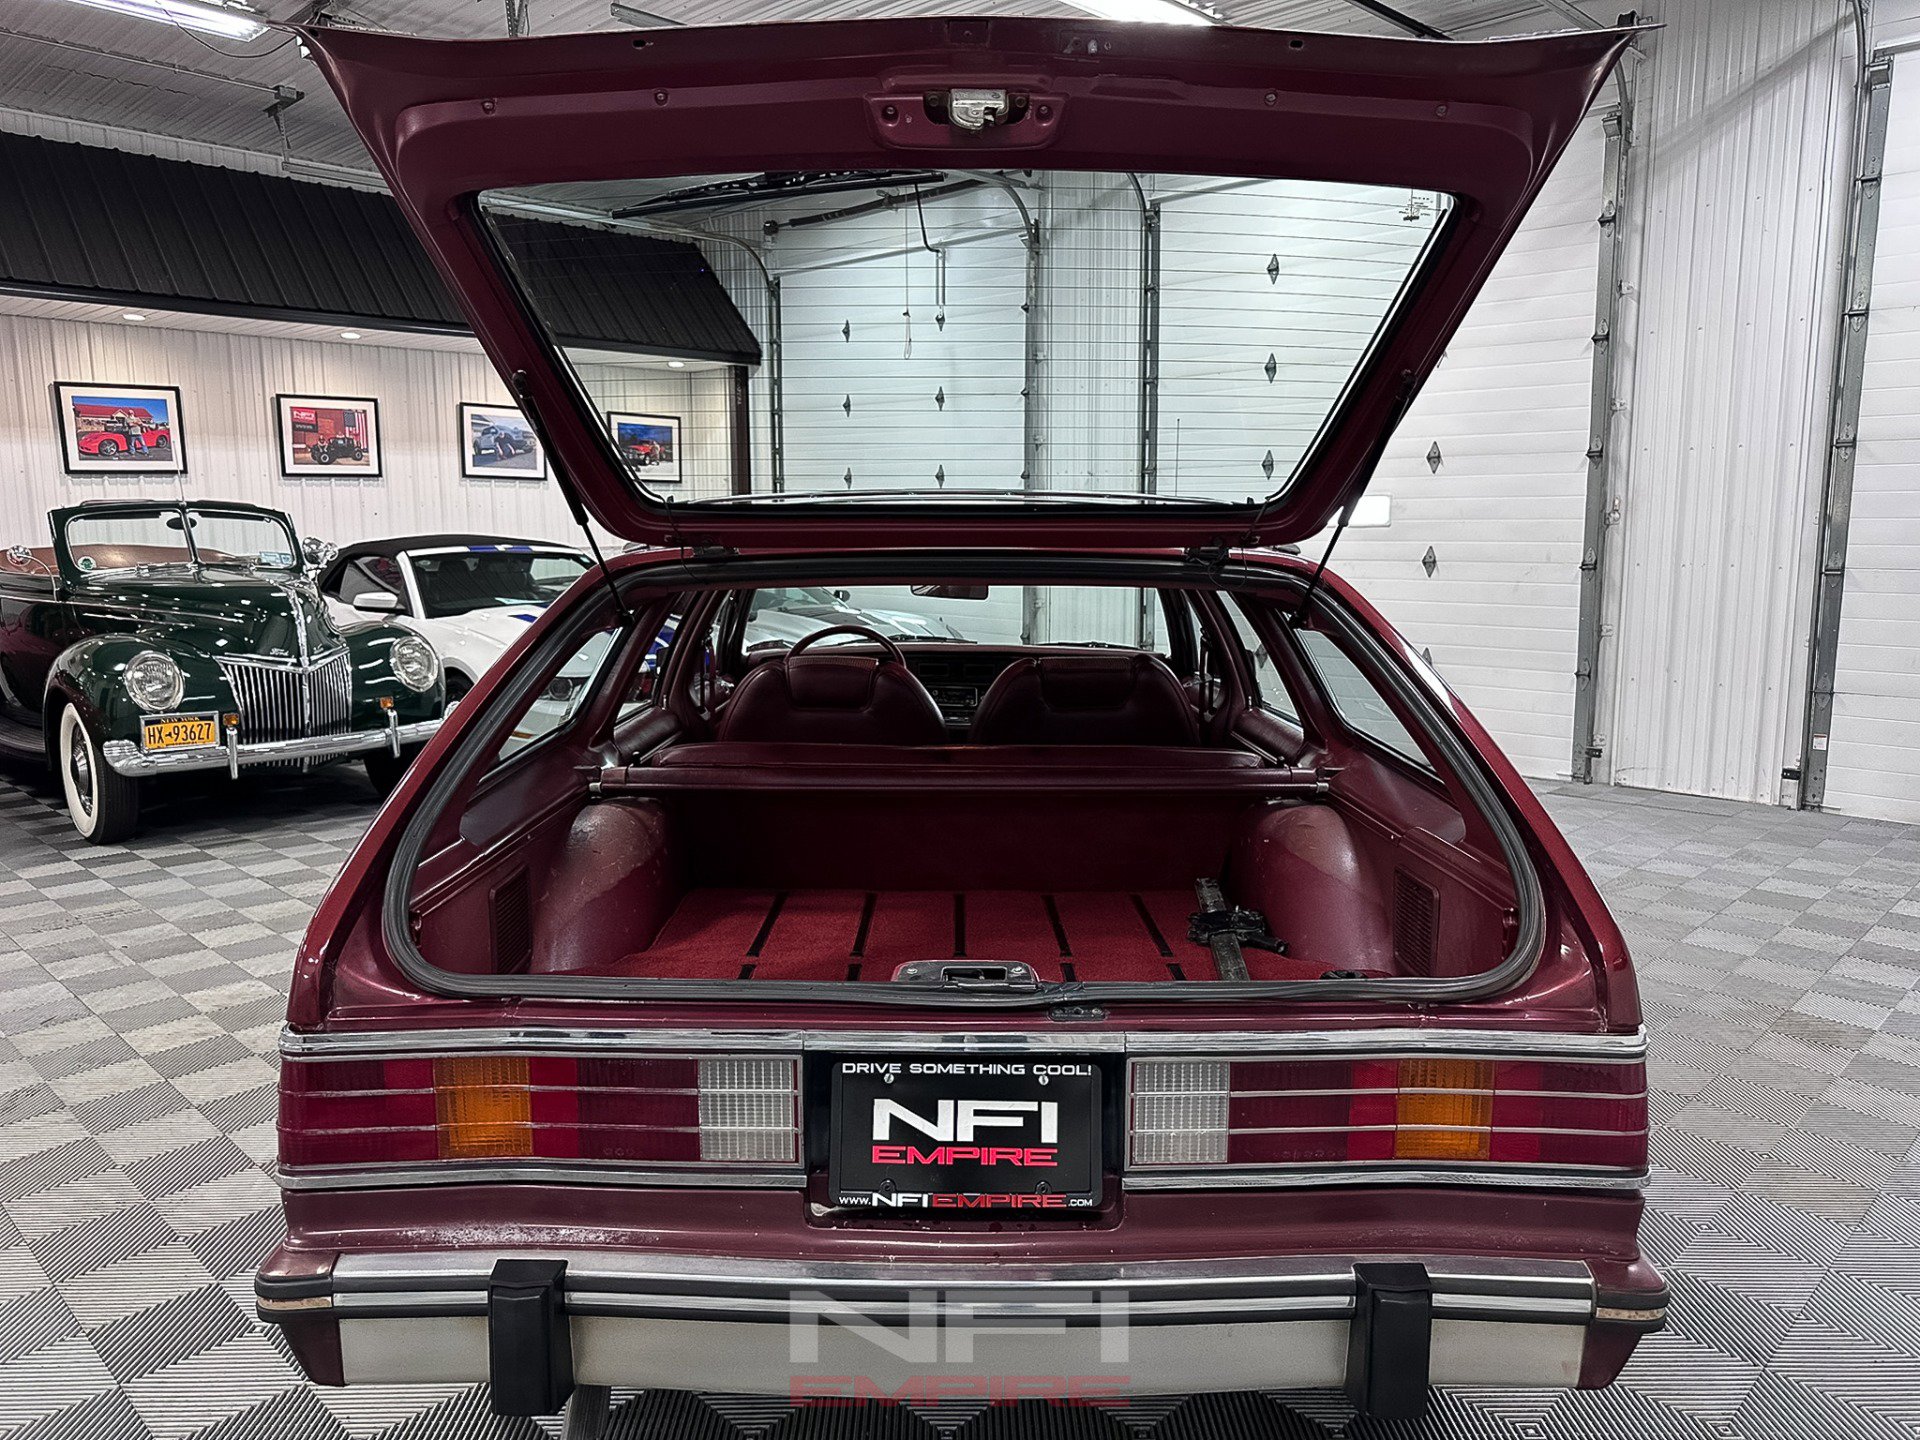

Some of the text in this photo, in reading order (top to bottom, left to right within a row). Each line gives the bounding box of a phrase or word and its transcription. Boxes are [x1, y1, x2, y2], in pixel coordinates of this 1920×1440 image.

[842, 1063, 1093, 1076] DRIVE SOMETHING COOL!
[872, 1098, 1059, 1144] NFI
[871, 1145, 1059, 1167] EMPIRE
